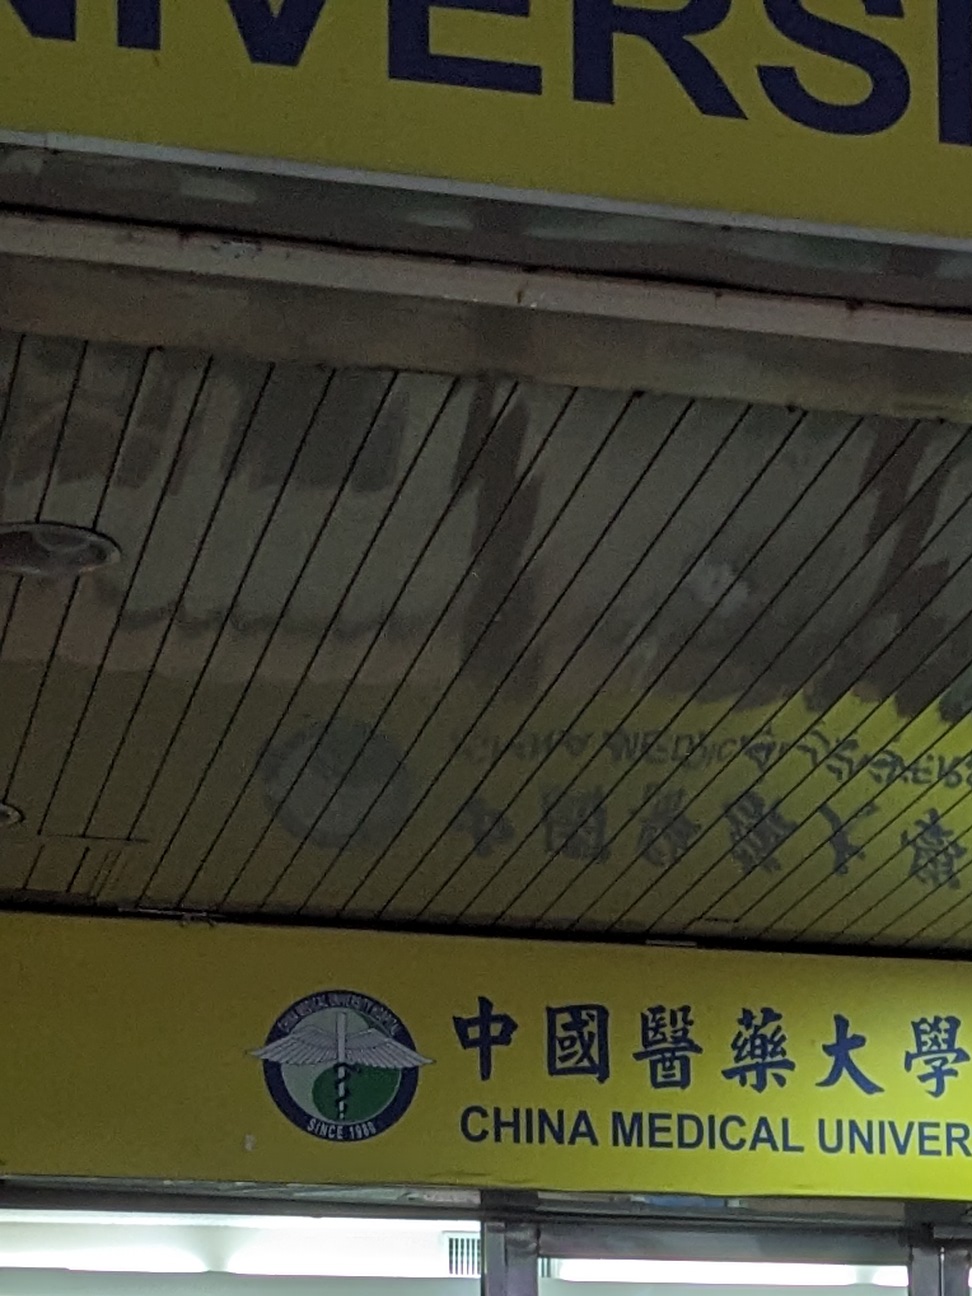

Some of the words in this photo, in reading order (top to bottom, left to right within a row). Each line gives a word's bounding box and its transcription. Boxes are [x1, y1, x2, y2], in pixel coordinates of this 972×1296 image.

[307, 1118, 344, 1140] SINCE
[461, 1105, 598, 1147] CHINA
[612, 1113, 804, 1153] MEDICAL
